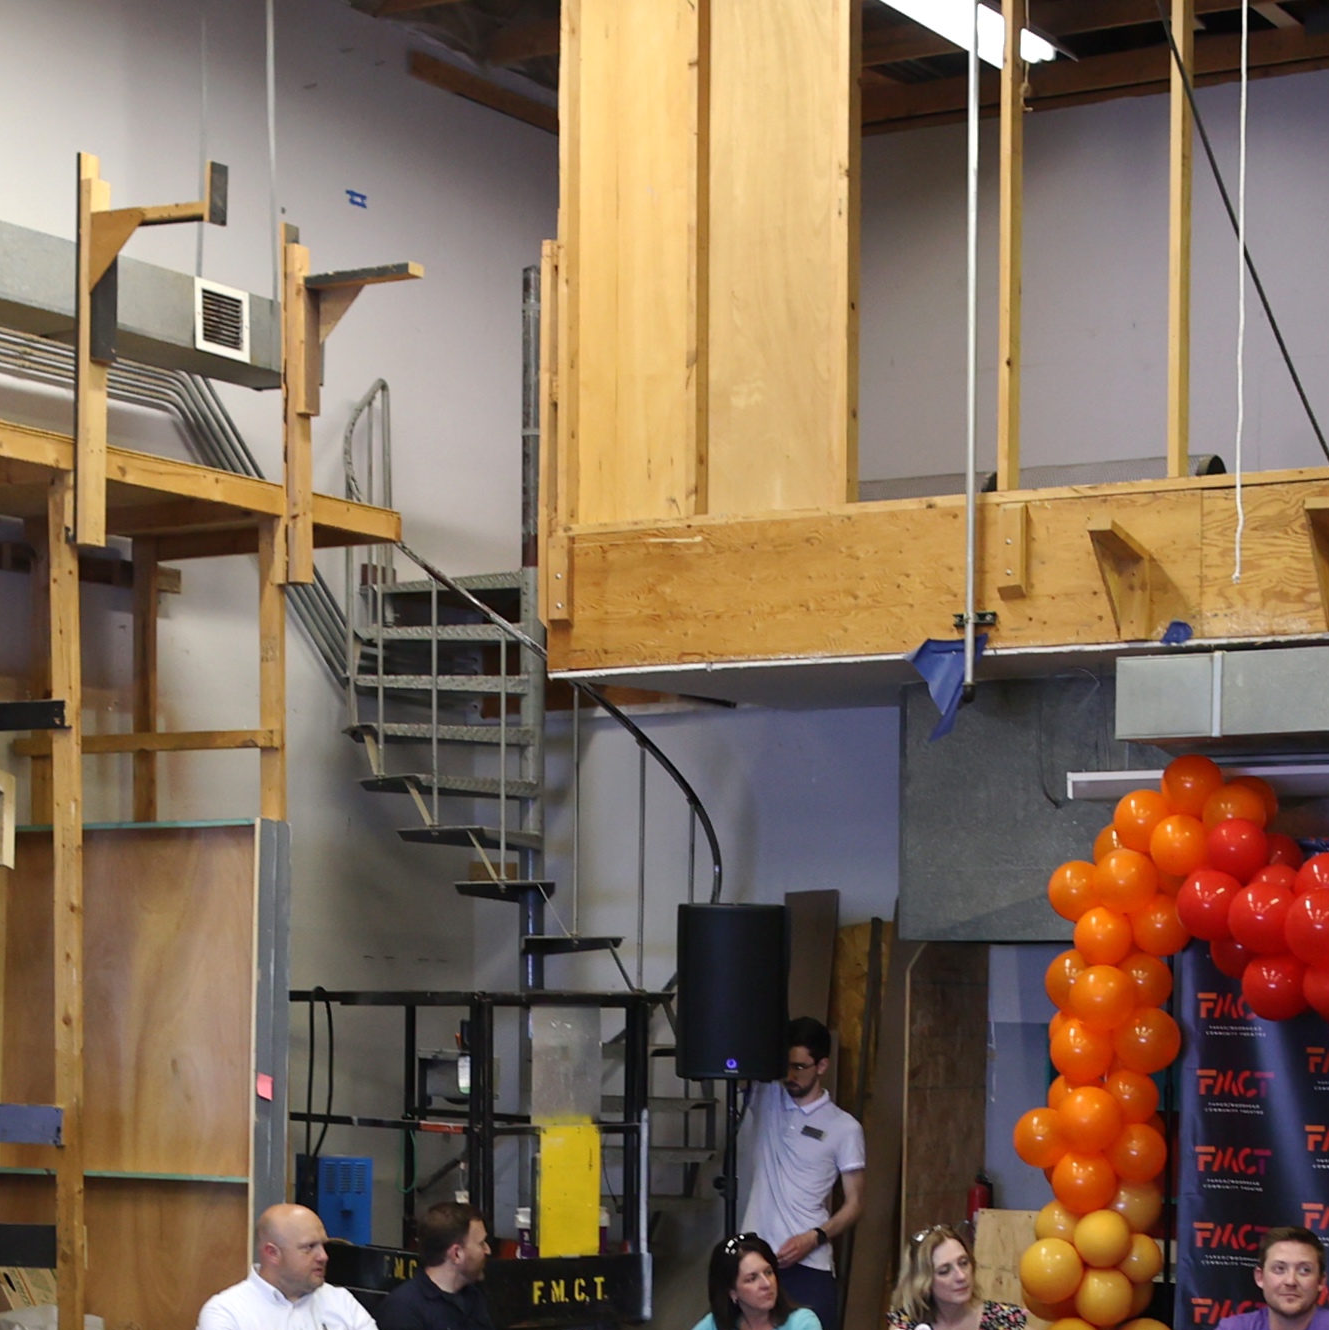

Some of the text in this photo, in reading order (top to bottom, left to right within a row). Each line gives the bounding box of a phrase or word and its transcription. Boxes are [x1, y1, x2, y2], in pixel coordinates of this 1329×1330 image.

[1197, 992, 1257, 1020] FMC
[1196, 1069, 1275, 1098] FMCT
[1195, 1146, 1272, 1175] FMCT
